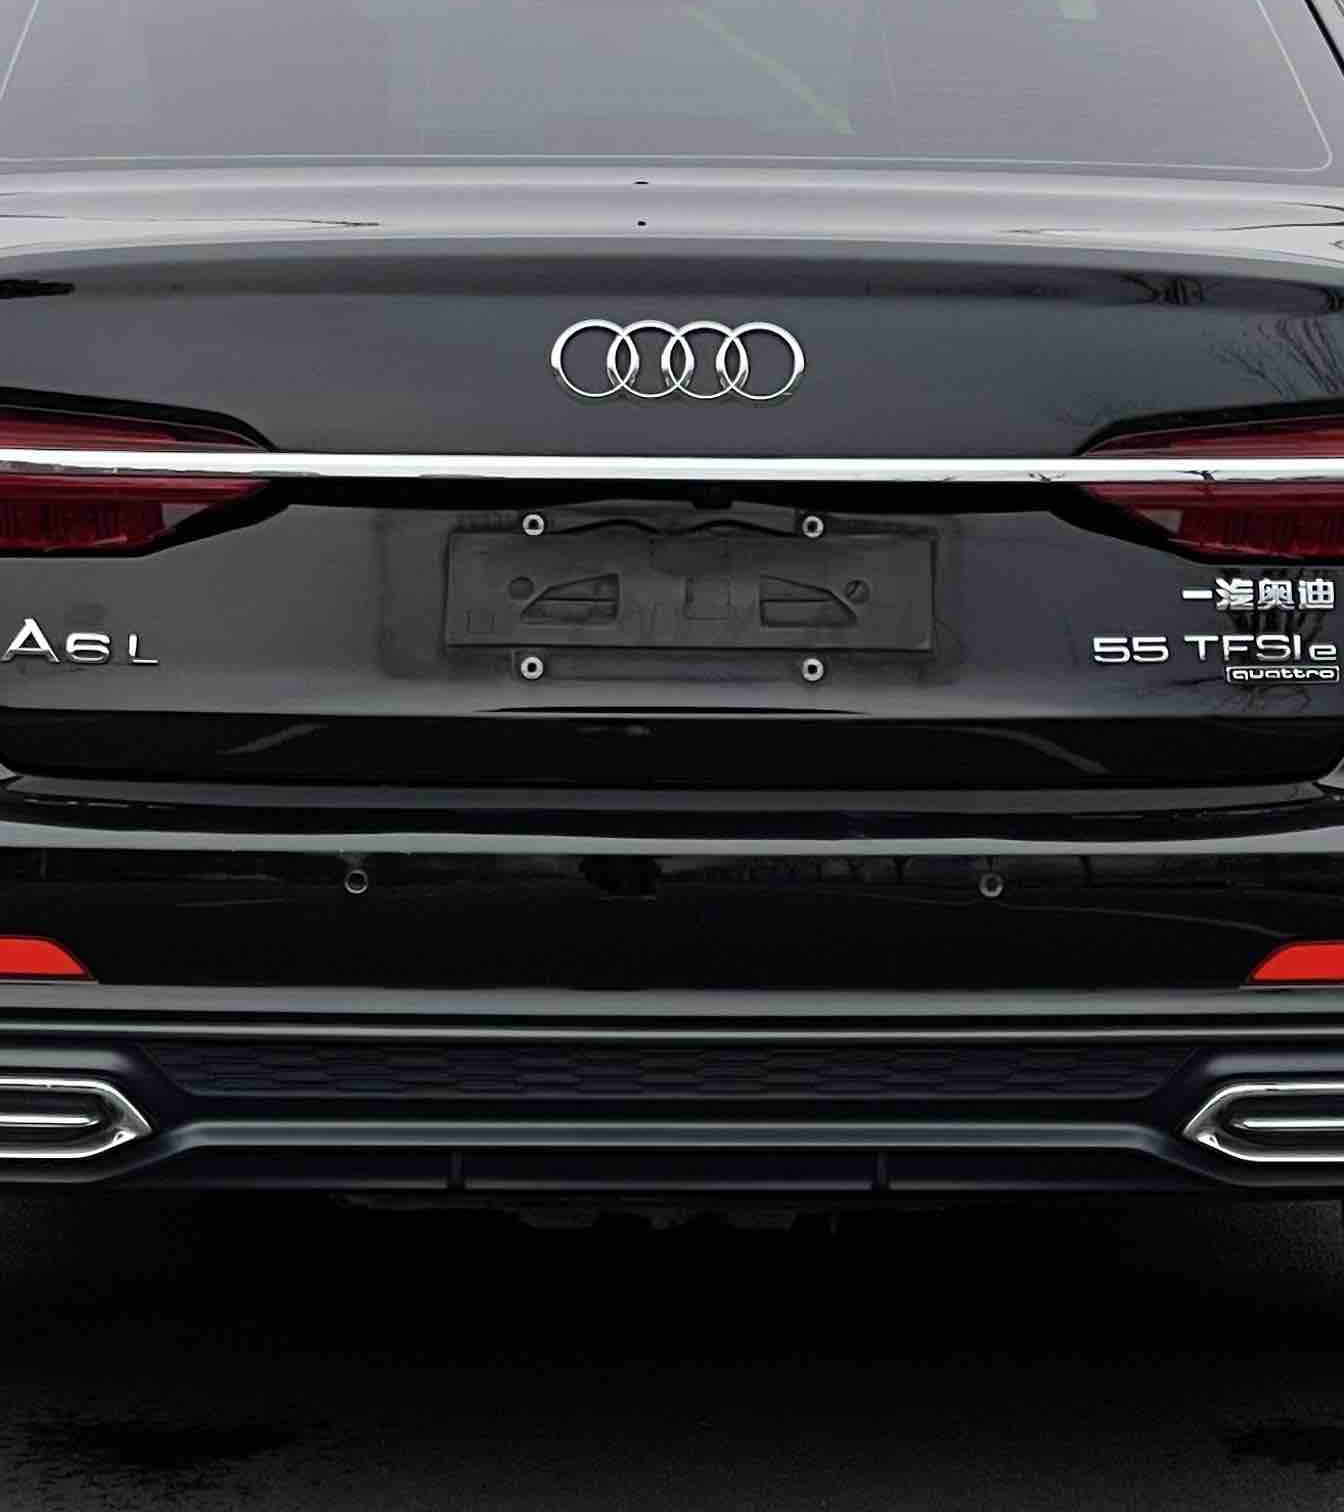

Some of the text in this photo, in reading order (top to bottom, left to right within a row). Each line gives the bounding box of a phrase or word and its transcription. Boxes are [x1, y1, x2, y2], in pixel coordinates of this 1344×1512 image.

[1182, 578, 1335, 610] 一汽奥迪
[0, 618, 159, 663] A6L
[1093, 637, 1169, 663] 55
[1232, 668, 1336, 681] quattro
